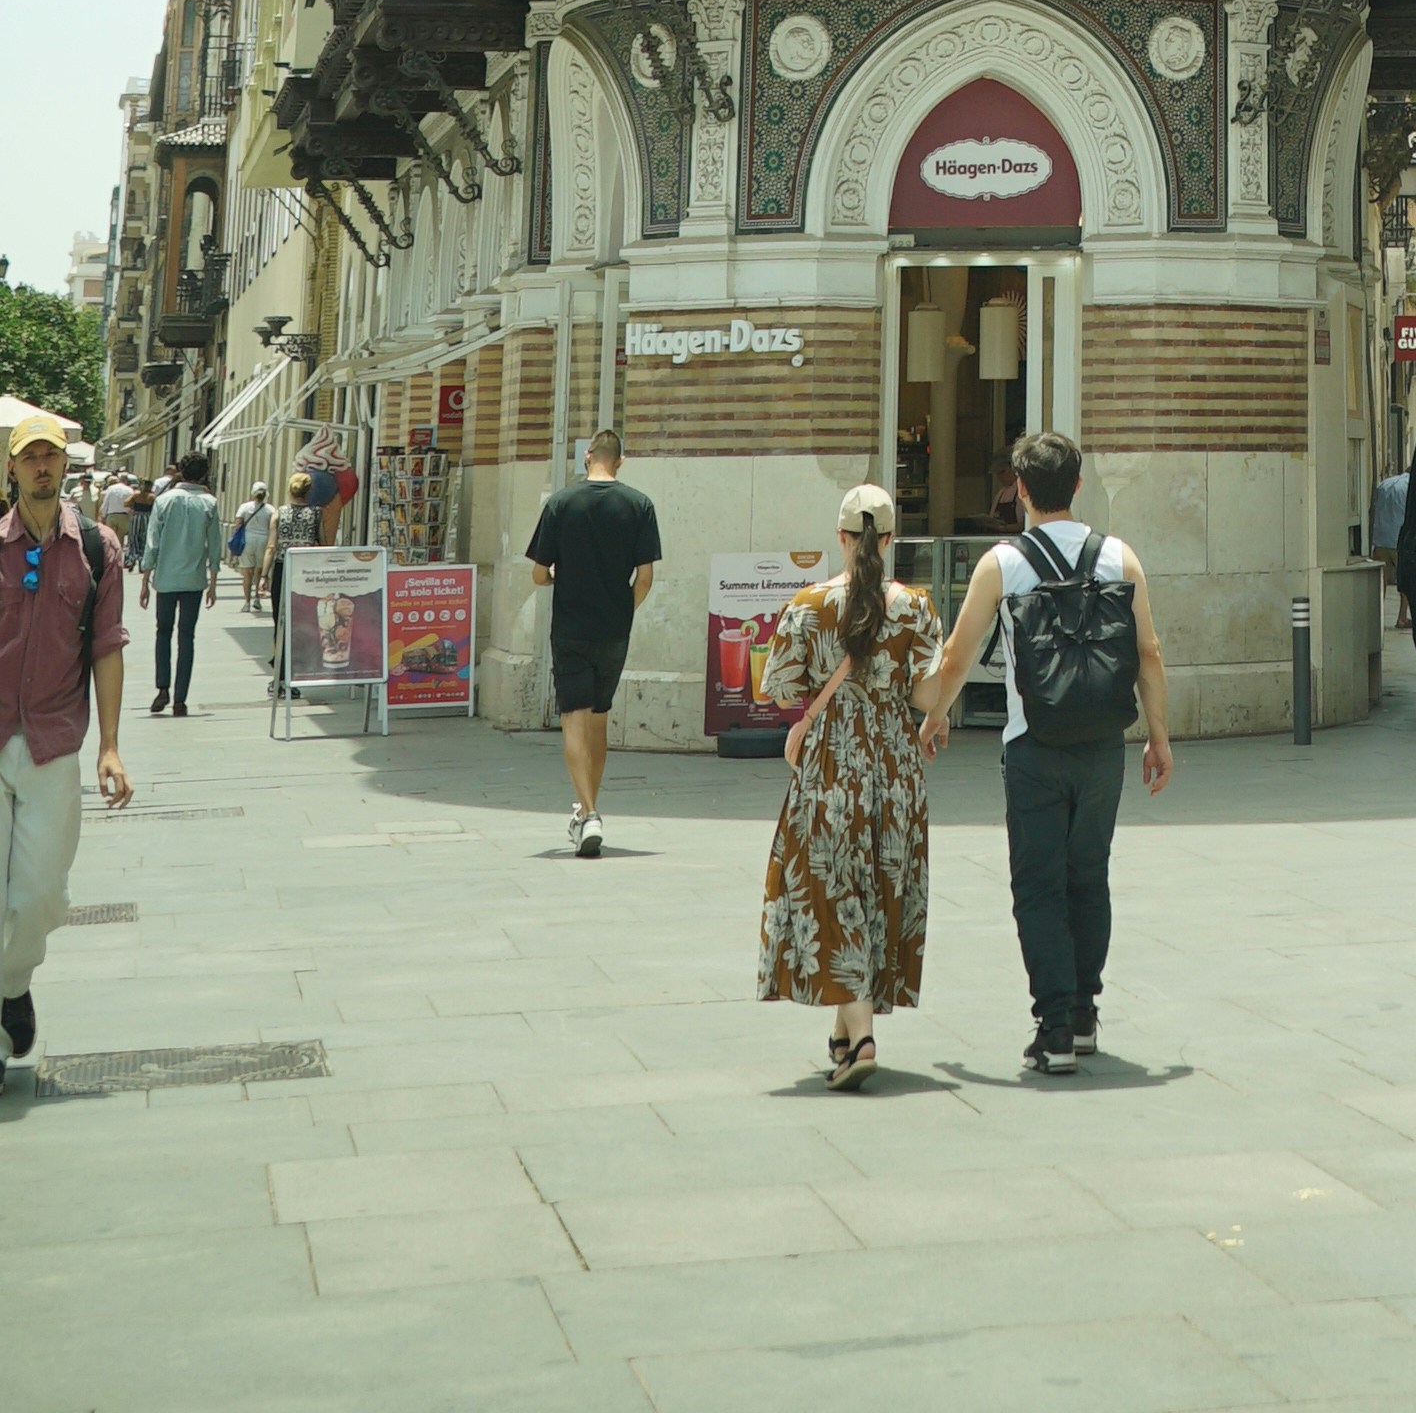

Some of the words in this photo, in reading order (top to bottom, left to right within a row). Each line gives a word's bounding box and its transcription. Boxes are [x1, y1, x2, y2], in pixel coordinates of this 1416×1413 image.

[404, 577, 440, 589] ¡Sevilla
[442, 577, 456, 585] en
[719, 579, 760, 591] Summer
[395, 589, 409, 598] un
[410, 587, 432, 597] solo
[433, 586, 465, 596] ticket!
